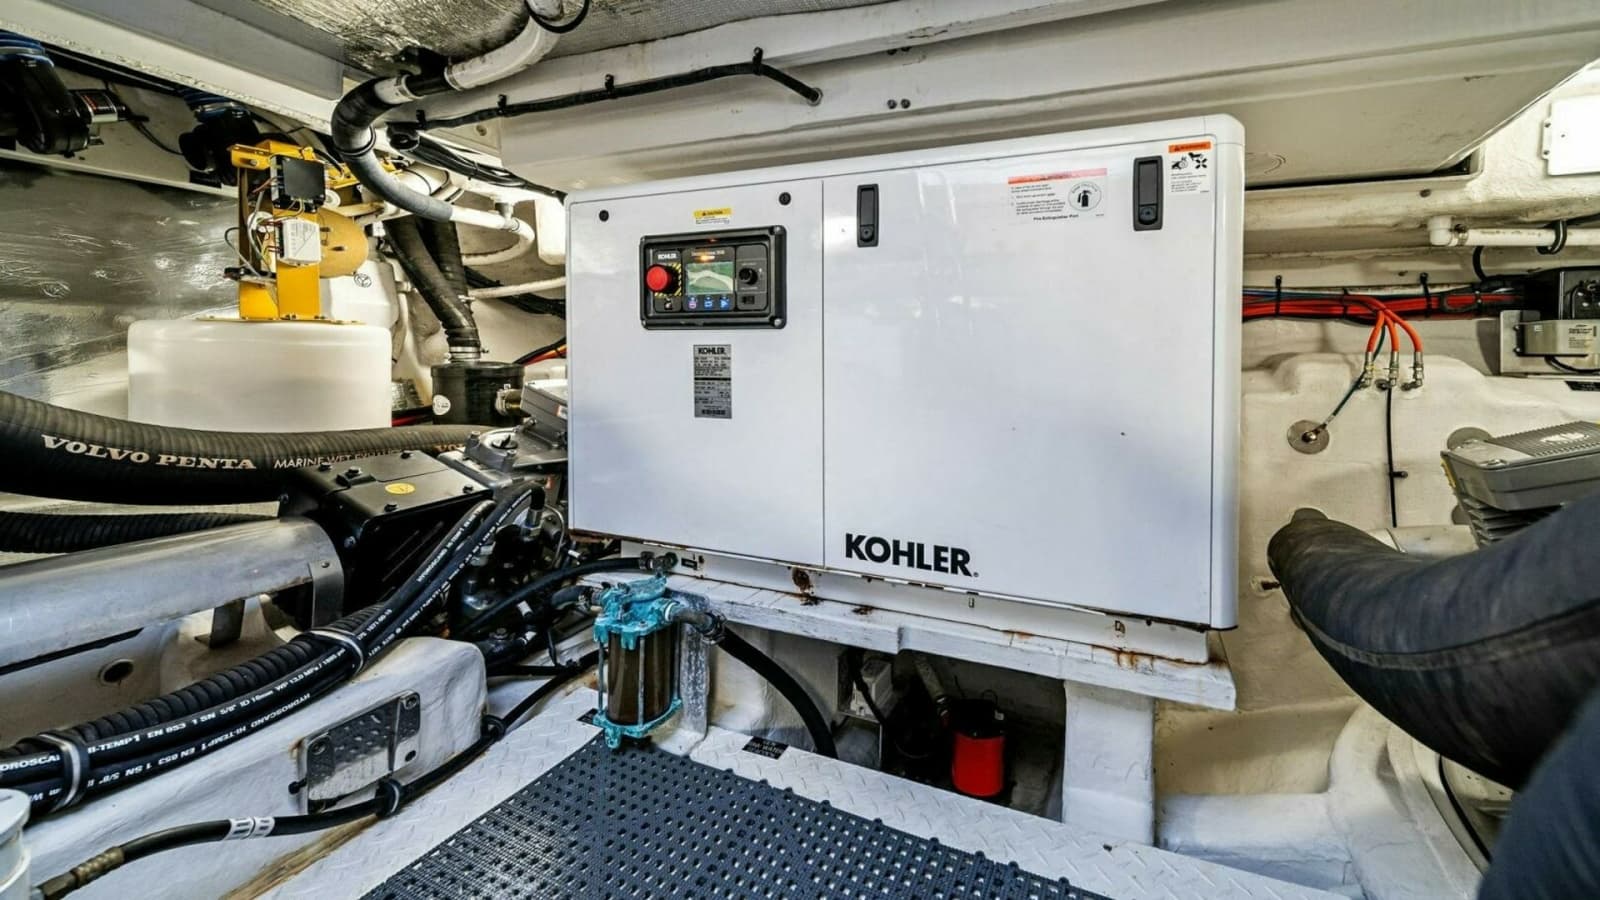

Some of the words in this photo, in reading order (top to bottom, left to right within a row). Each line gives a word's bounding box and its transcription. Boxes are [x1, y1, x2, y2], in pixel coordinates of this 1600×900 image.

[698, 347, 726, 355] KOHLER
[41, 434, 151, 464] VOLVO
[155, 453, 257, 470] PENTA
[273, 455, 325, 469] MARINE
[845, 533, 973, 577] KOHLER
[250, 693, 311, 728] HYDROSCAND
[147, 728, 164, 739] EN
[165, 723, 187, 733] 853
[199, 712, 216, 722] SN
[158, 753, 179, 765] 853
[180, 747, 196, 758] EN
[125, 765, 143, 777] SN
